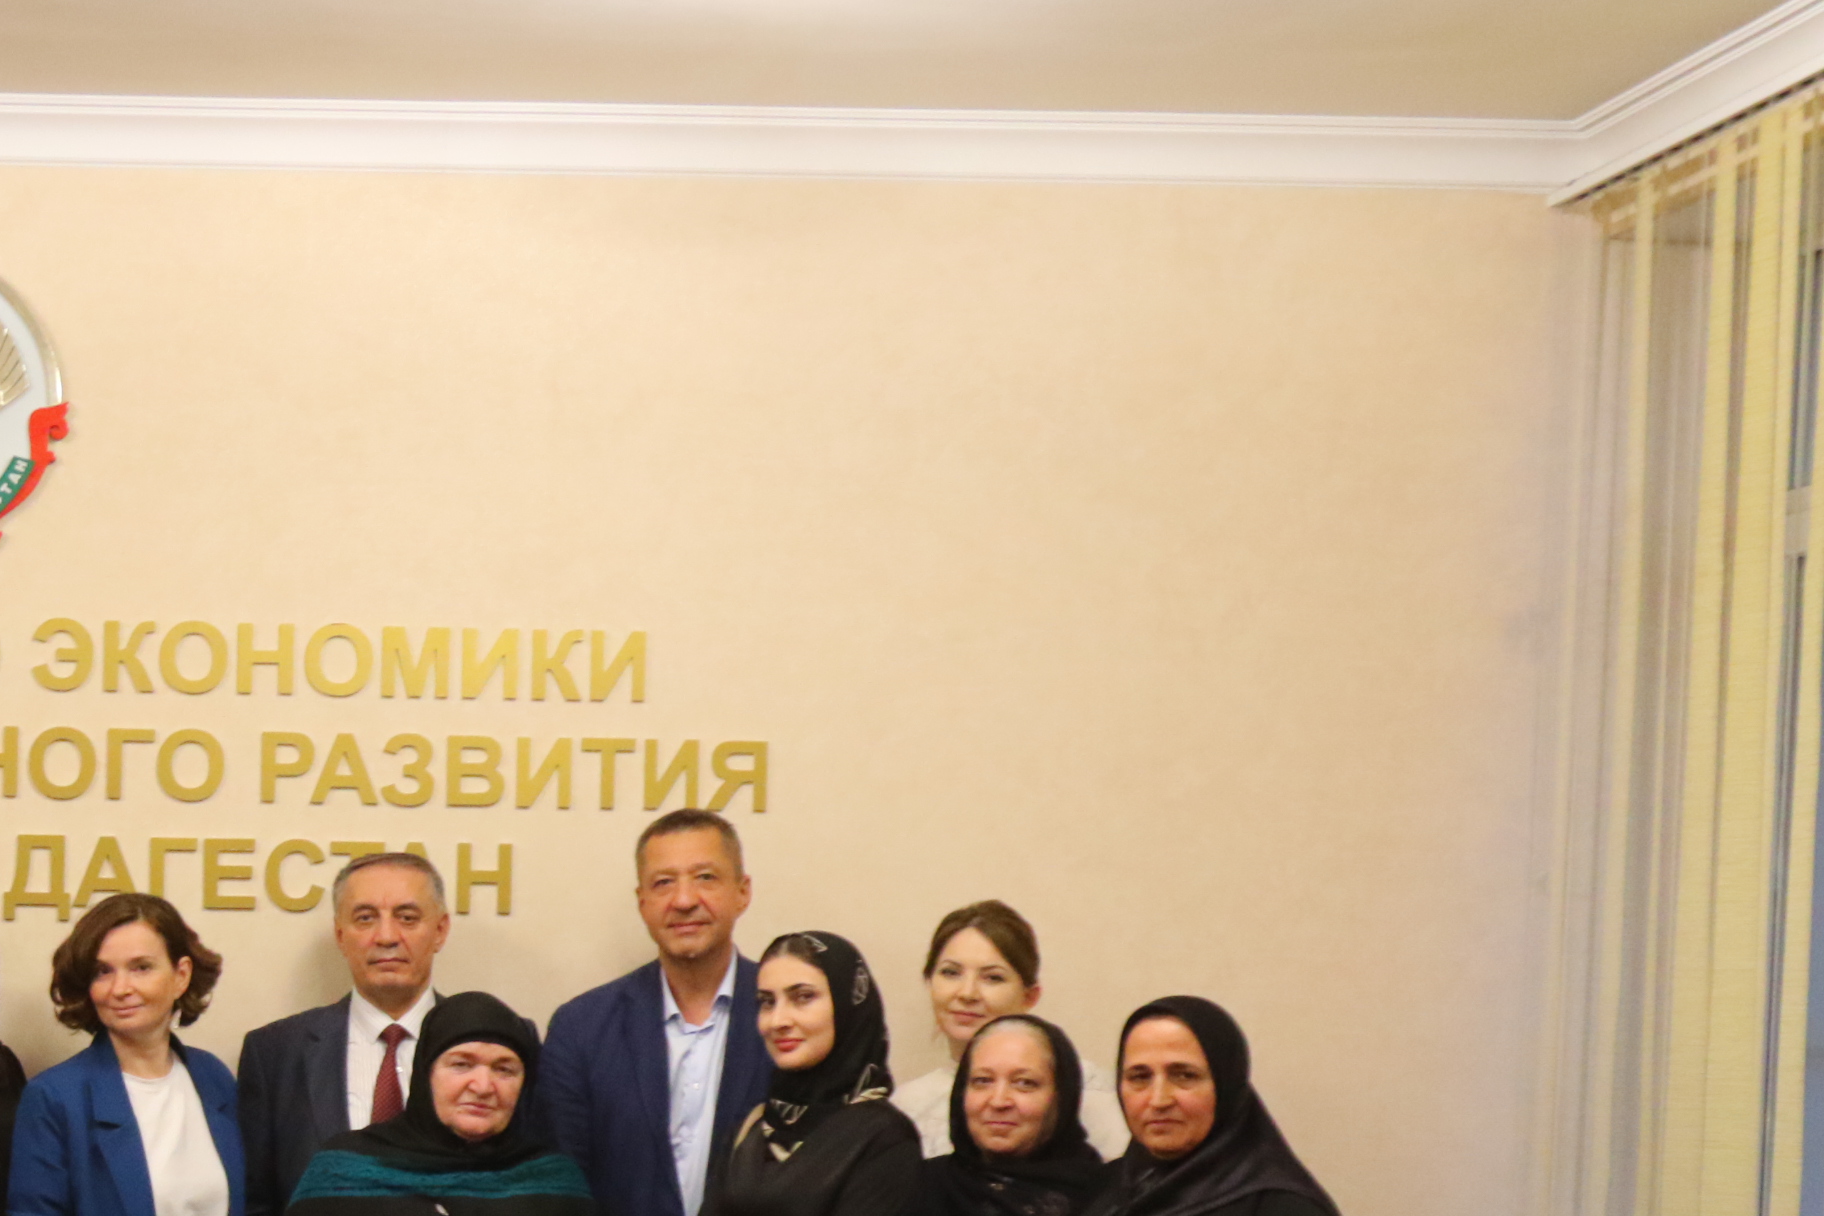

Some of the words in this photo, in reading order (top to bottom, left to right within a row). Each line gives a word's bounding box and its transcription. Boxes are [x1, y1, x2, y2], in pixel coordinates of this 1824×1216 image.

[31, 617, 648, 703] ЭКОНОМИКИ
[260, 731, 769, 813] РАЗВИТИЯ
[2, 835, 514, 921] ДАГЕСН
